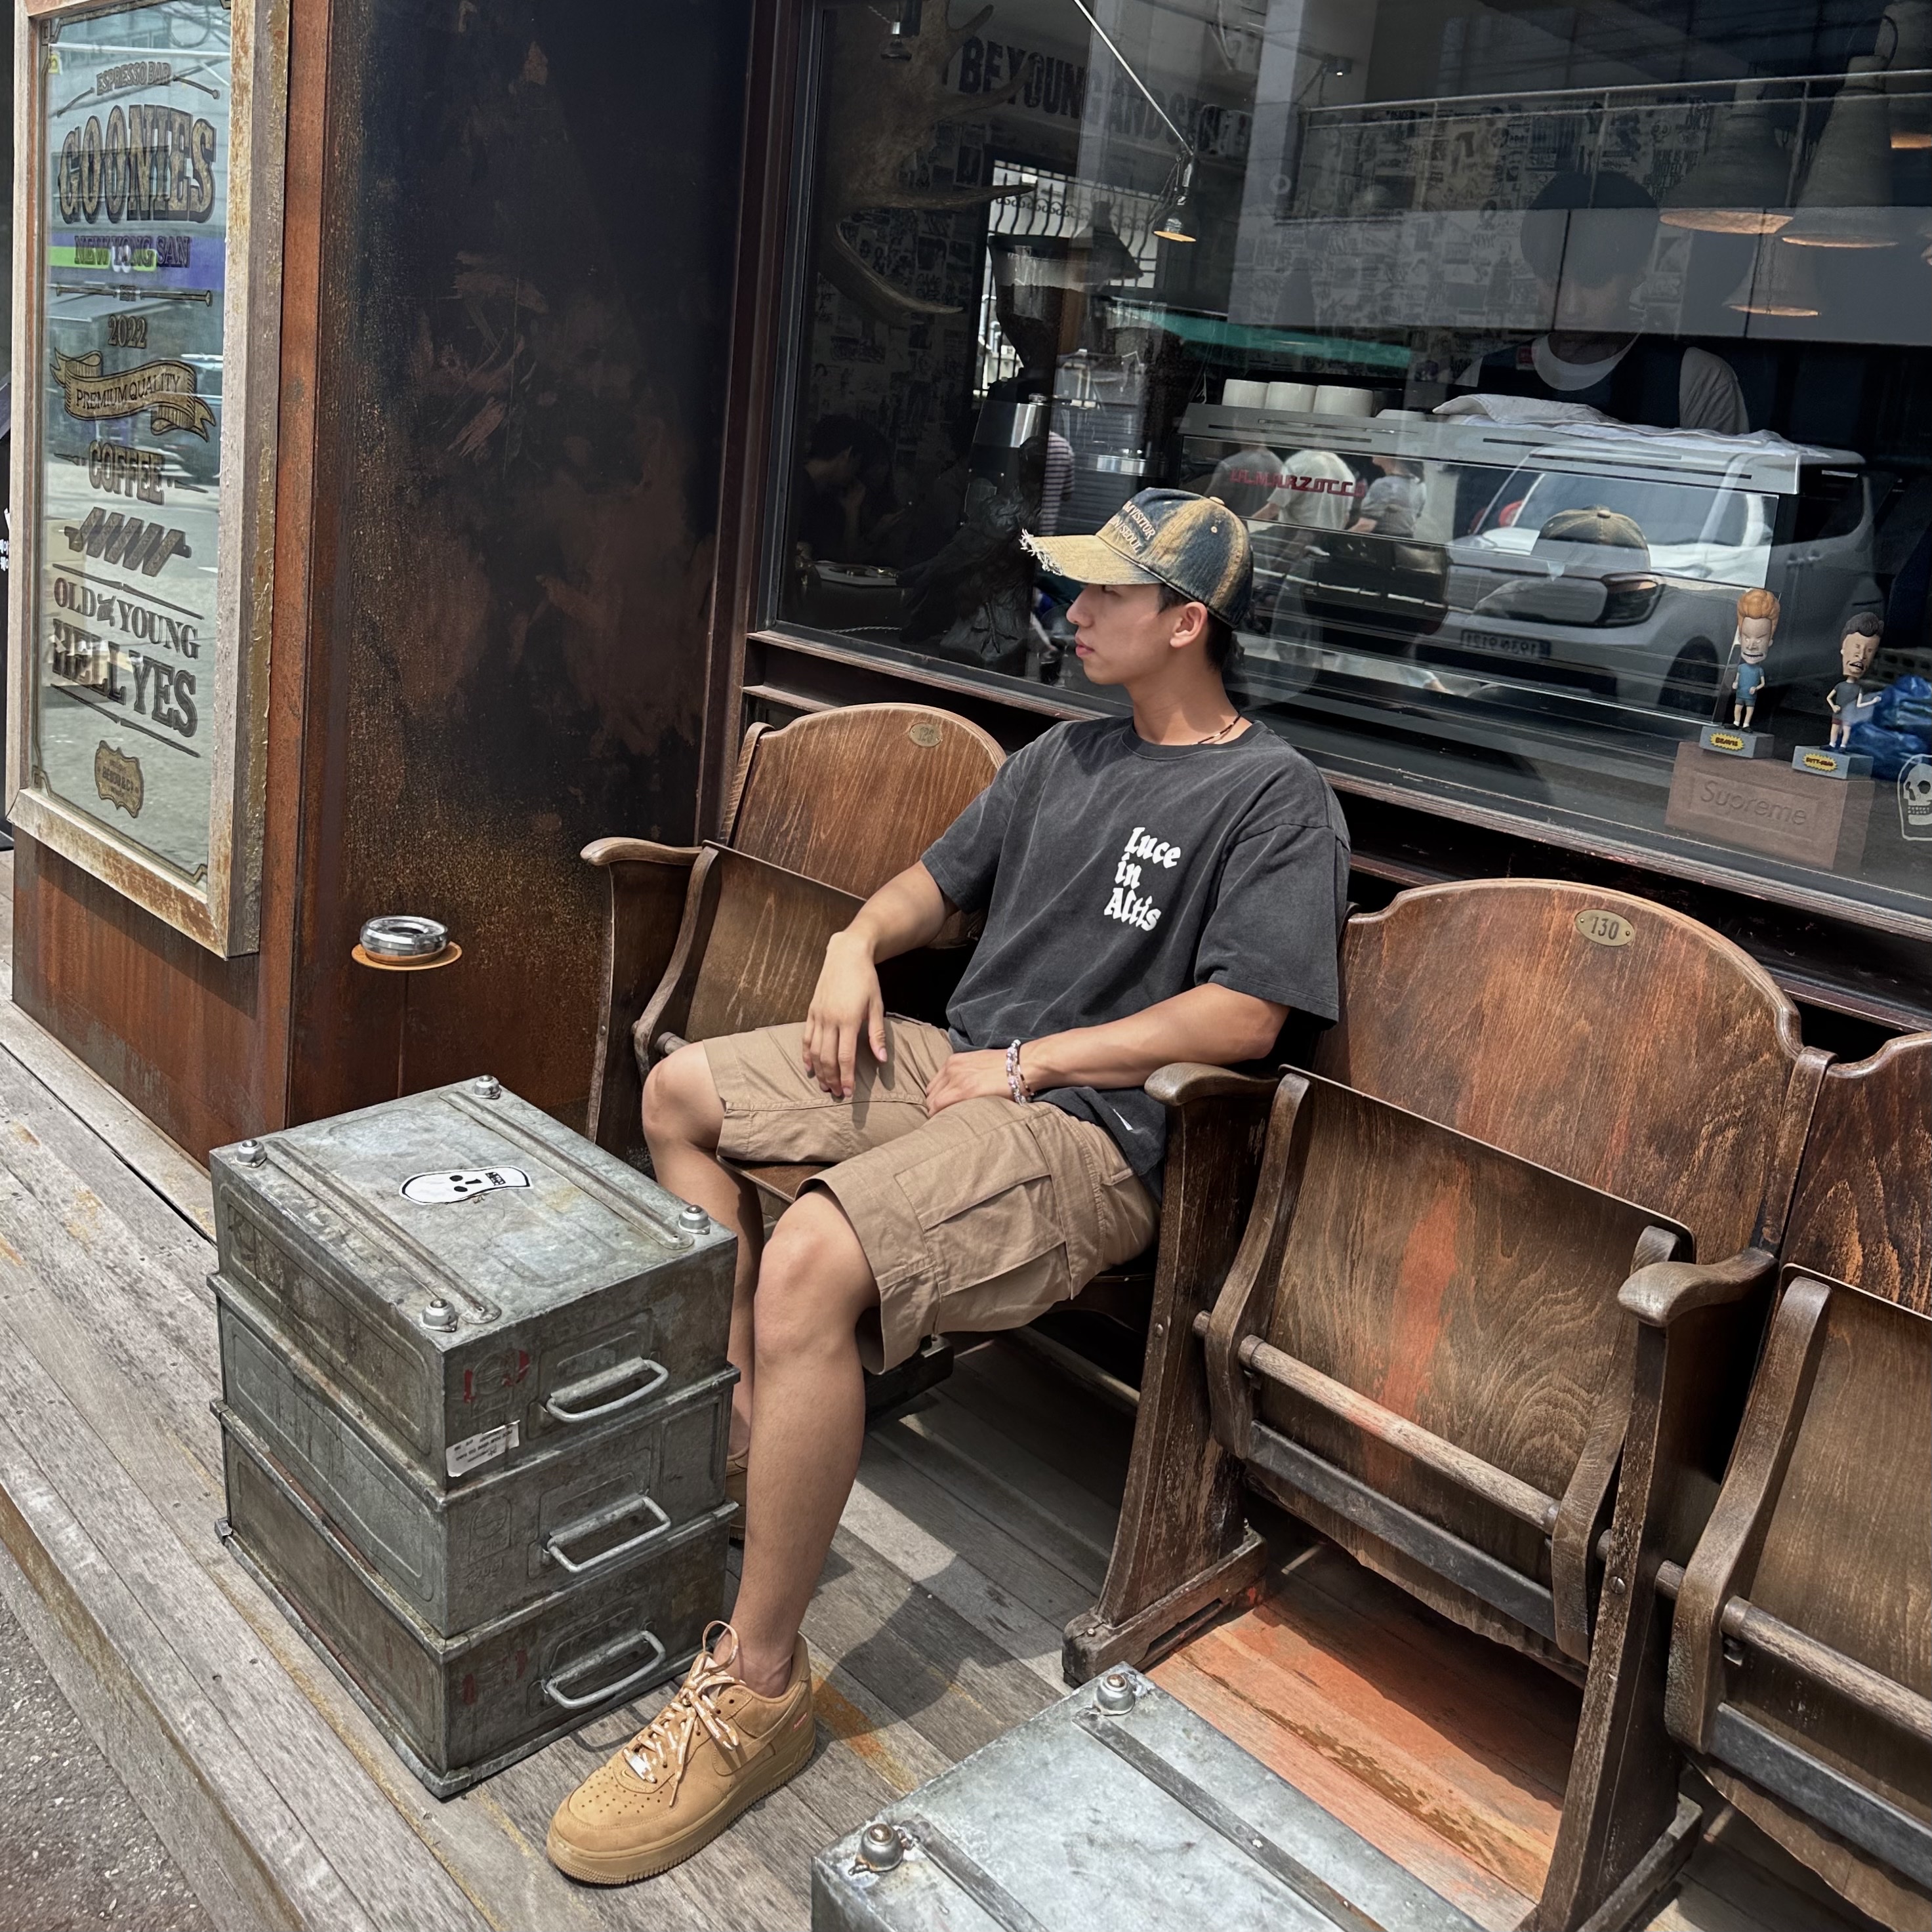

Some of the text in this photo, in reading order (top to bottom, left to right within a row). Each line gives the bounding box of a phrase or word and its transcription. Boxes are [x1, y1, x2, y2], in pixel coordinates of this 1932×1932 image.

[96, 61, 172, 96] ESPRESSO BAR
[58, 104, 217, 224] GOONIES
[74, 236, 190, 268] NEW YONG SAN
[108, 314, 147, 349] 2022
[76, 373, 180, 410] PREMIUM QUALITY
[89, 440, 164, 505] COFFEE
[1129, 506, 1156, 541] VISITOR
[53, 577, 97, 618] OLD
[116, 599, 201, 660] YOUNG
[52, 618, 198, 738] HELL YES
[1700, 779, 1807, 825] Supreme
[1124, 827, 1182, 869] Luce
[1115, 852, 1142, 890] in
[1590, 916, 1620, 940] 130
